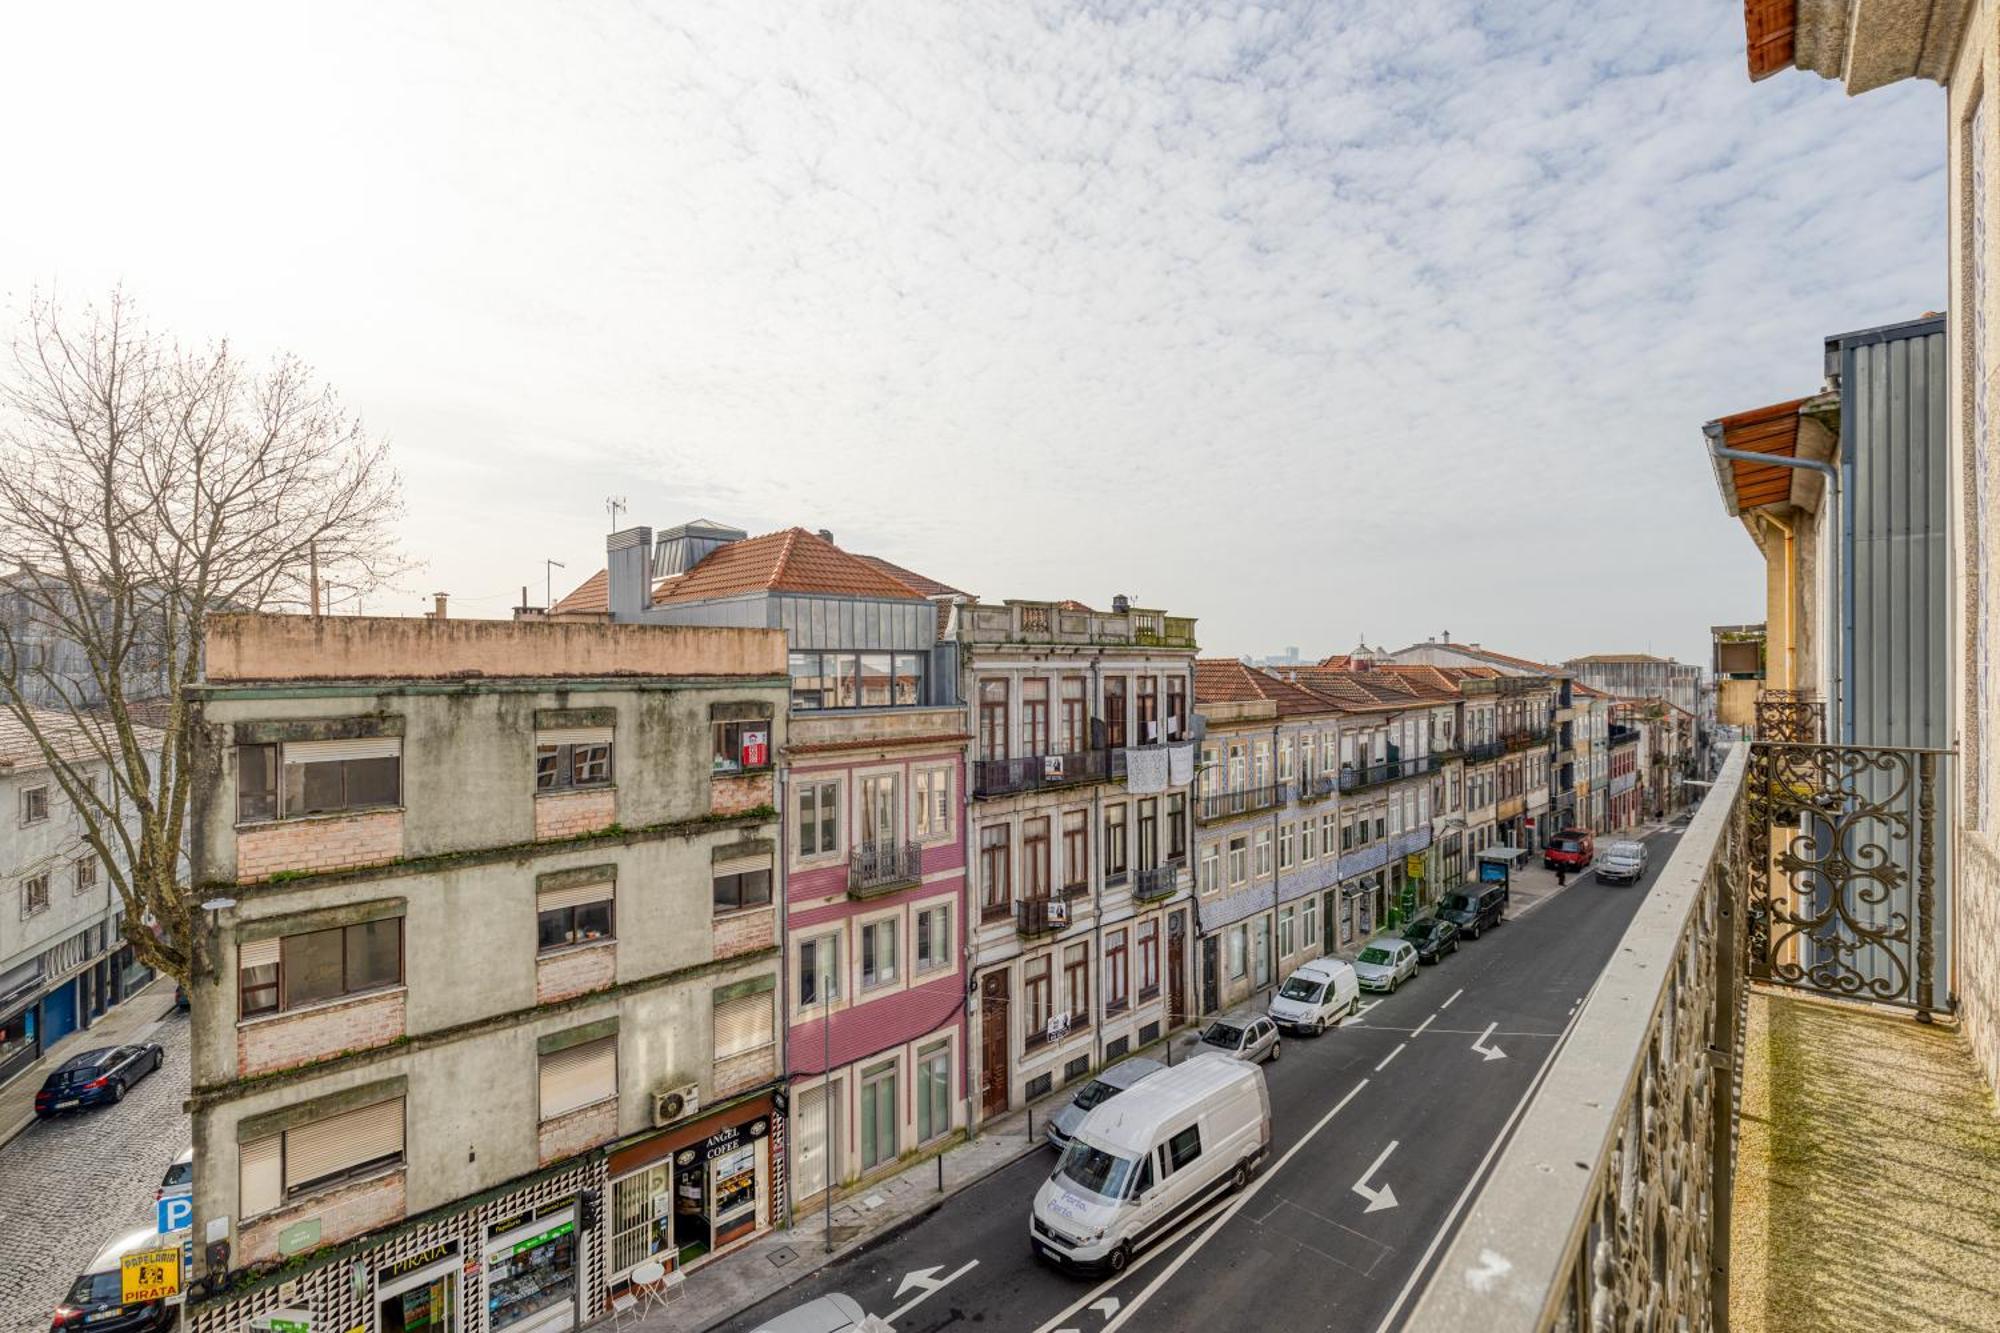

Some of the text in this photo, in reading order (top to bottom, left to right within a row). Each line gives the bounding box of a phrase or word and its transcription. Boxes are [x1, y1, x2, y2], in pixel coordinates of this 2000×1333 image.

[707, 1127, 740, 1148] ANGEL
[707, 1139, 740, 1159] COFEE
[167, 1200, 192, 1230] P
[124, 1253, 177, 1269] PAPELARIA
[393, 1243, 447, 1275] PIRATA
[125, 1286, 177, 1301] PIRATA
